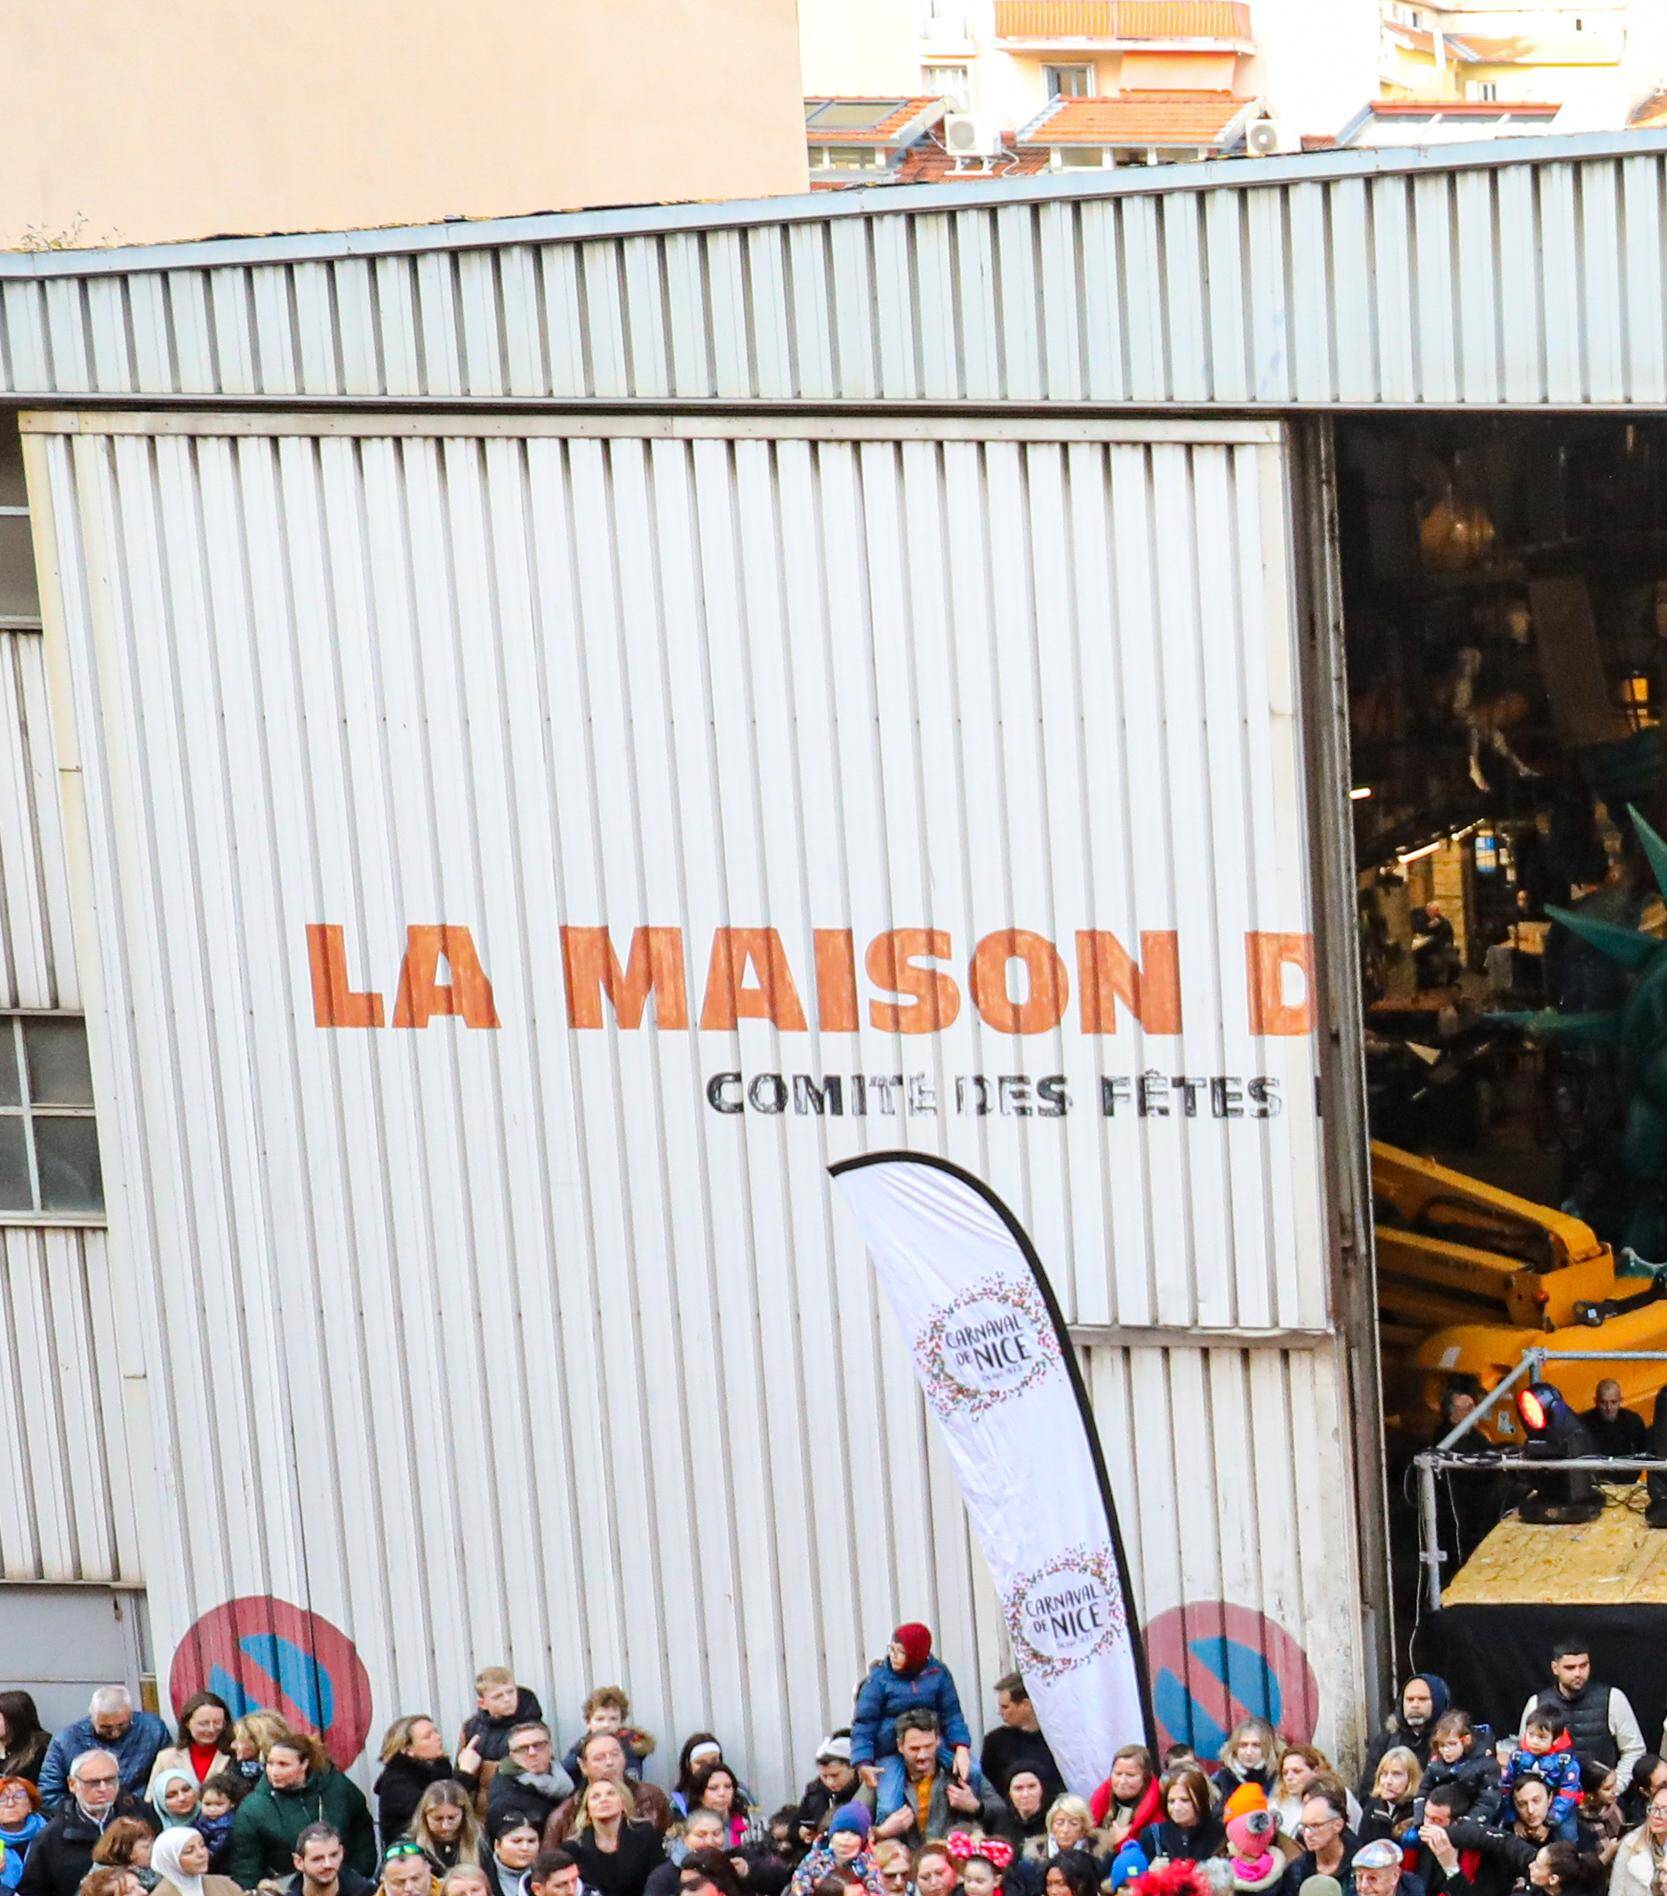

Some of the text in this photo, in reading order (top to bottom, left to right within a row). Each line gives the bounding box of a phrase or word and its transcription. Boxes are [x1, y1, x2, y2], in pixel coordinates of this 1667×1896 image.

[304, 923, 502, 1029] LA
[559, 924, 1183, 1036] MAISON
[954, 1073, 1073, 1117] DES
[1100, 1067, 1283, 1118] FÊTES
[945, 1313, 1023, 1349] CARNAVAL
[956, 1334, 1032, 1371] DE NICE
[1025, 1583, 1100, 1617] CARNAVAL
[1033, 1602, 1104, 1639] DE NICE
